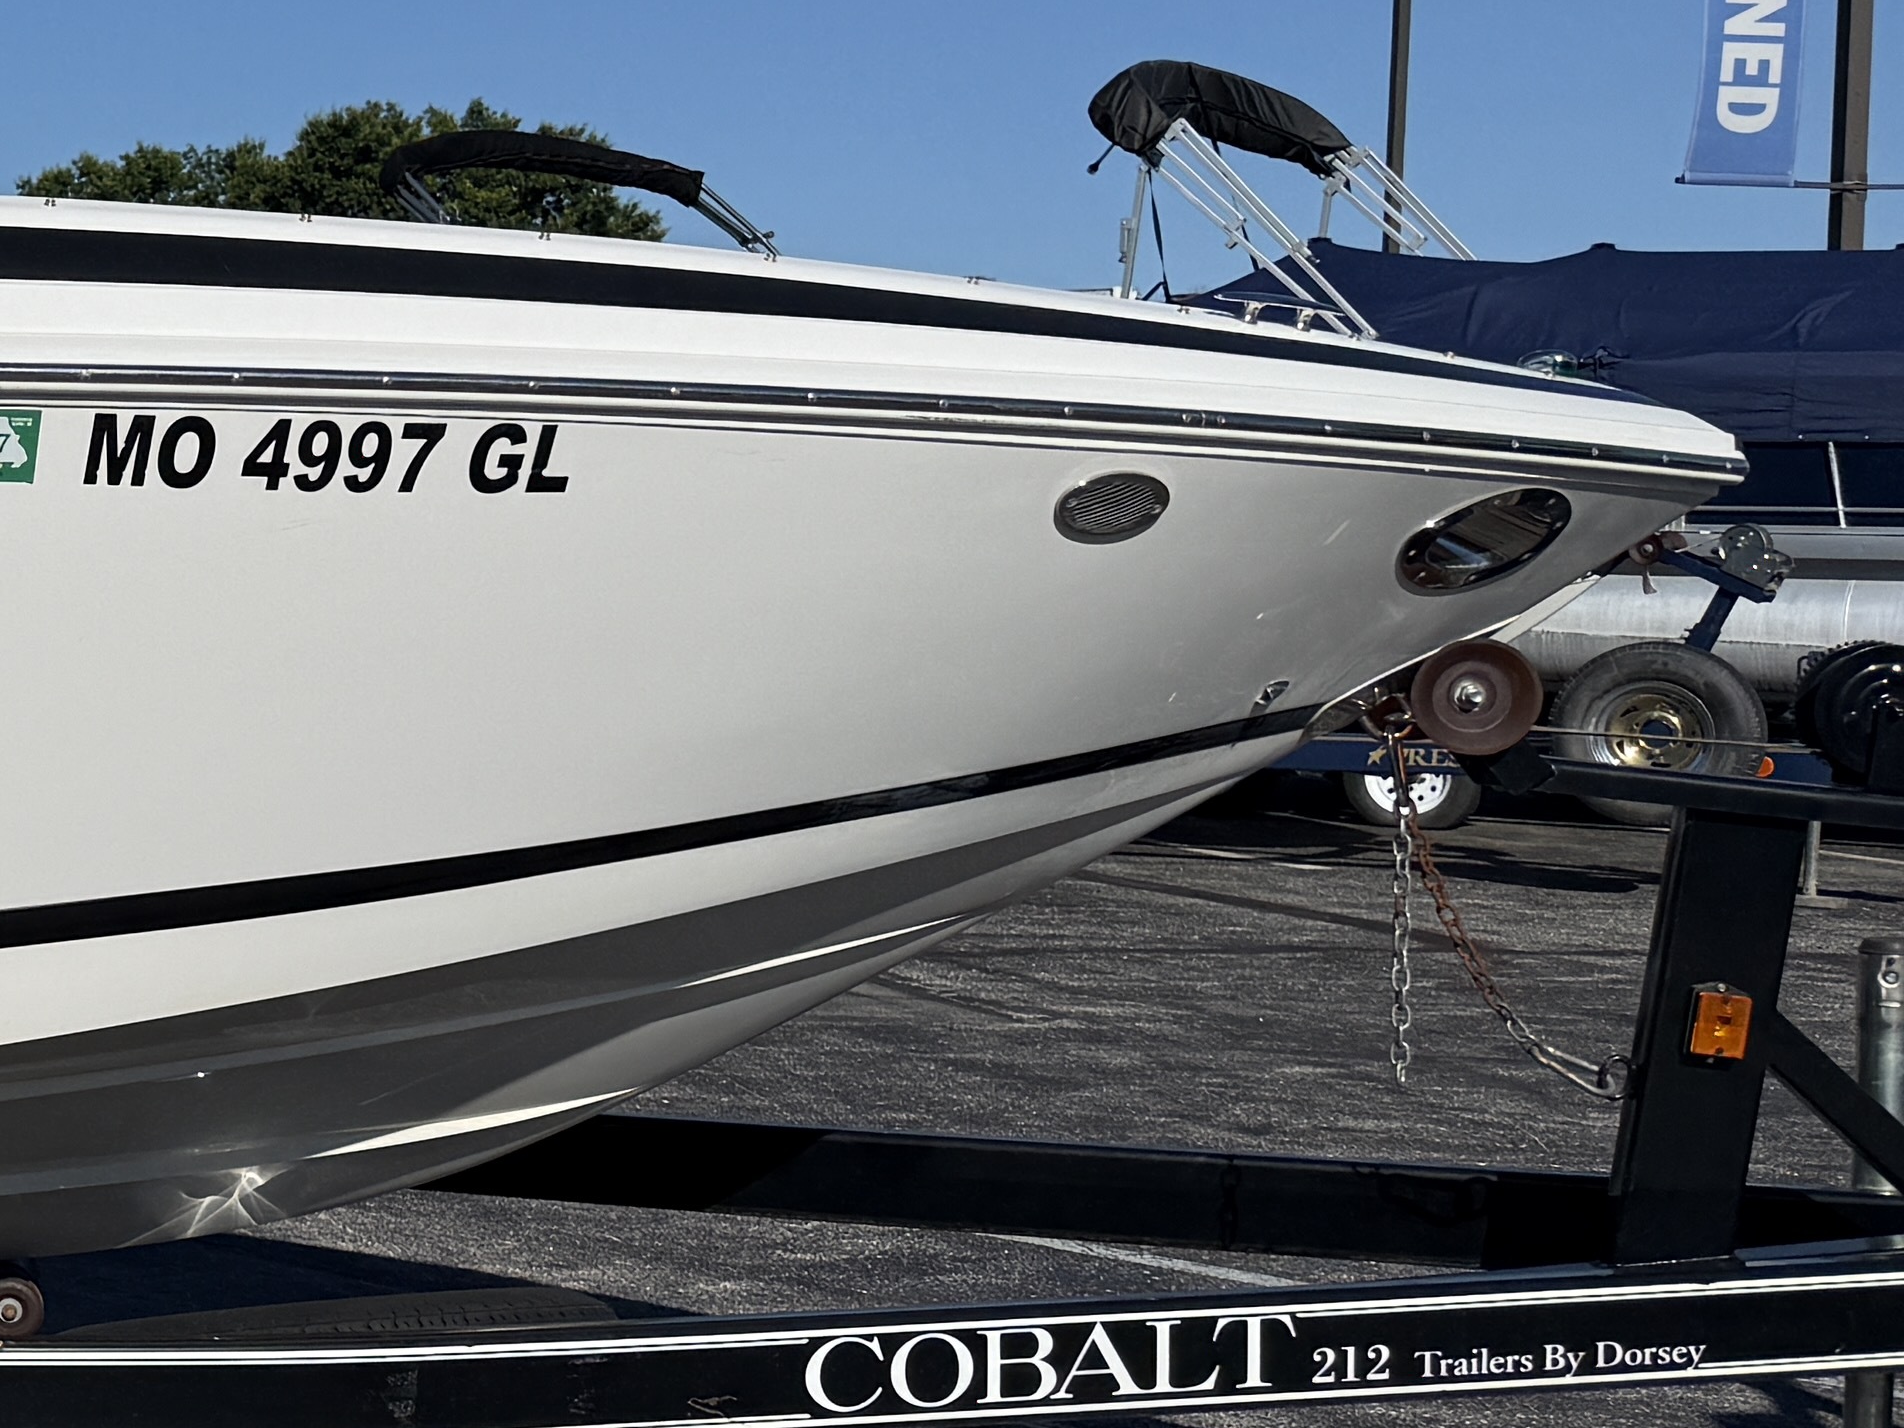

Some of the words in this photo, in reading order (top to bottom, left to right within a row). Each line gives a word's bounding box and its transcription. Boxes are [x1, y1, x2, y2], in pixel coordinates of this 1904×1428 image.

[82, 412, 216, 489] MO
[240, 418, 448, 494] 4997
[468, 422, 569, 494] GL
[804, 1314, 1297, 1414] COBALT
[1311, 1344, 1391, 1384] 212
[1413, 1347, 1534, 1378] Trailers
[1542, 1343, 1586, 1376] By
[1594, 1340, 1706, 1372] Dorsey
